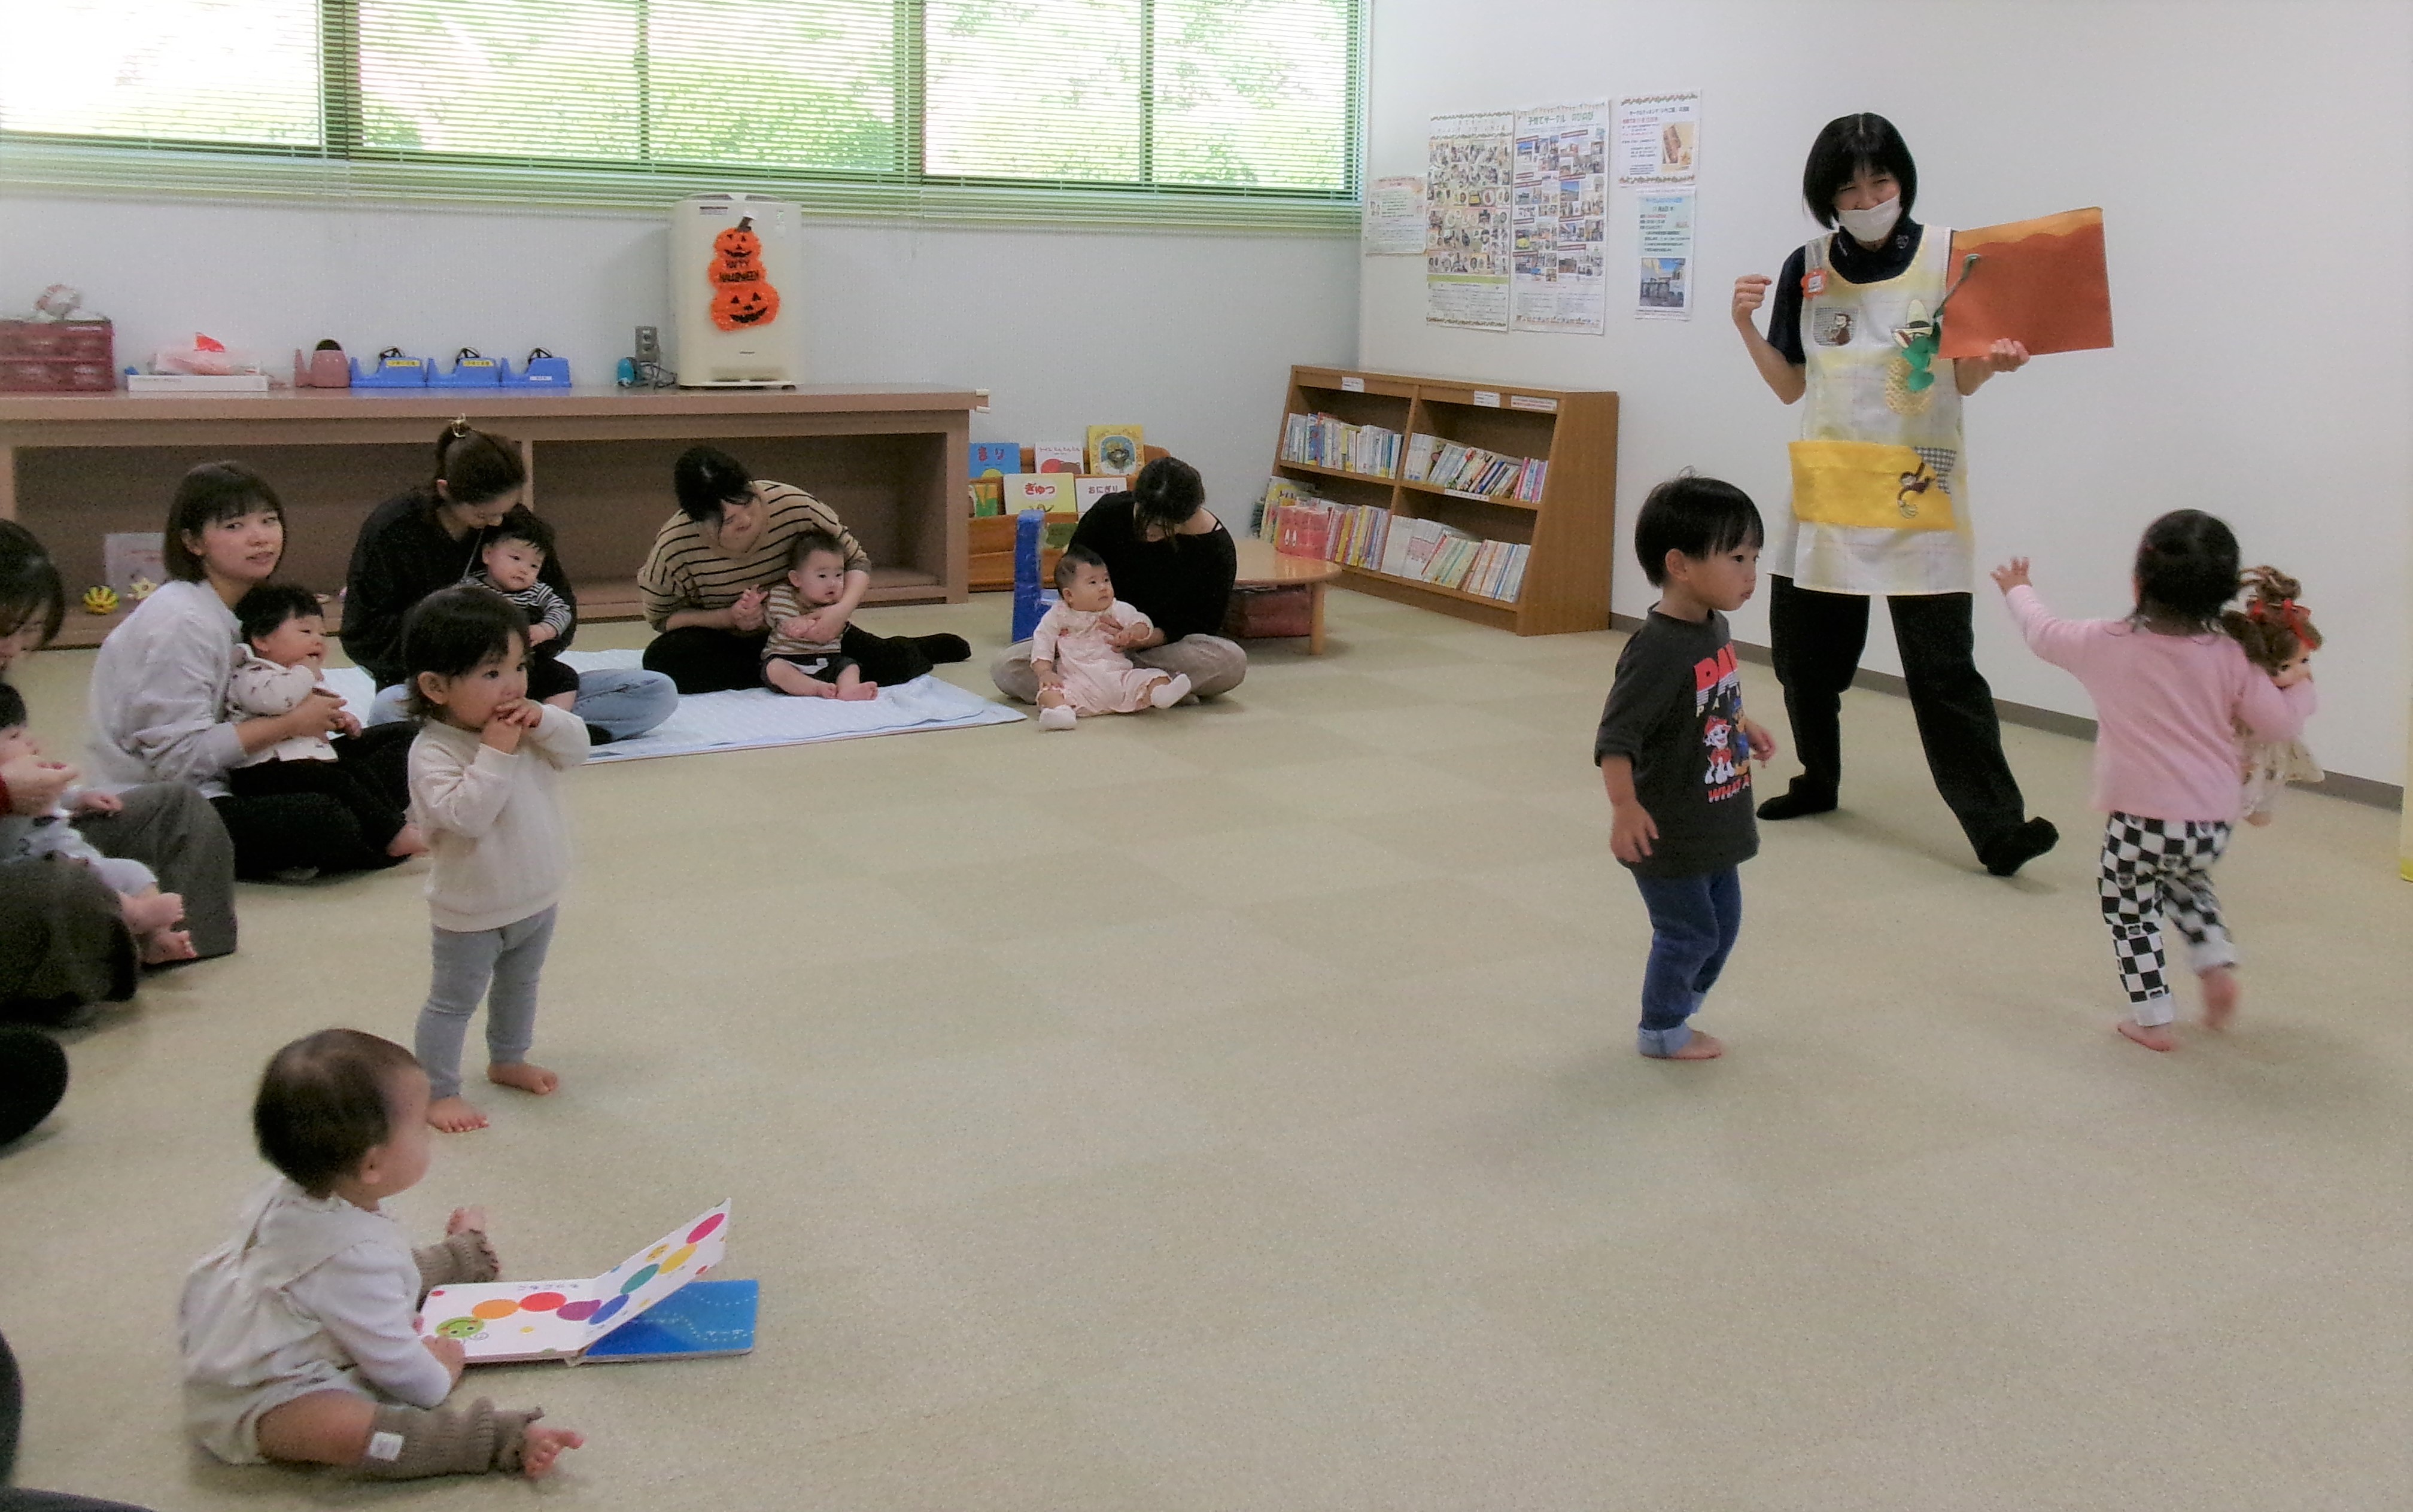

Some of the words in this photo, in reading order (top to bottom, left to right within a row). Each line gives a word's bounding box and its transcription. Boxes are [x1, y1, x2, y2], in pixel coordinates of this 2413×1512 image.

[725, 259, 750, 269] HAPPY
[719, 270, 759, 283] HALLOWEEN
[978, 446, 1005, 461] まり
[1089, 485, 1118, 494] おにぎり
